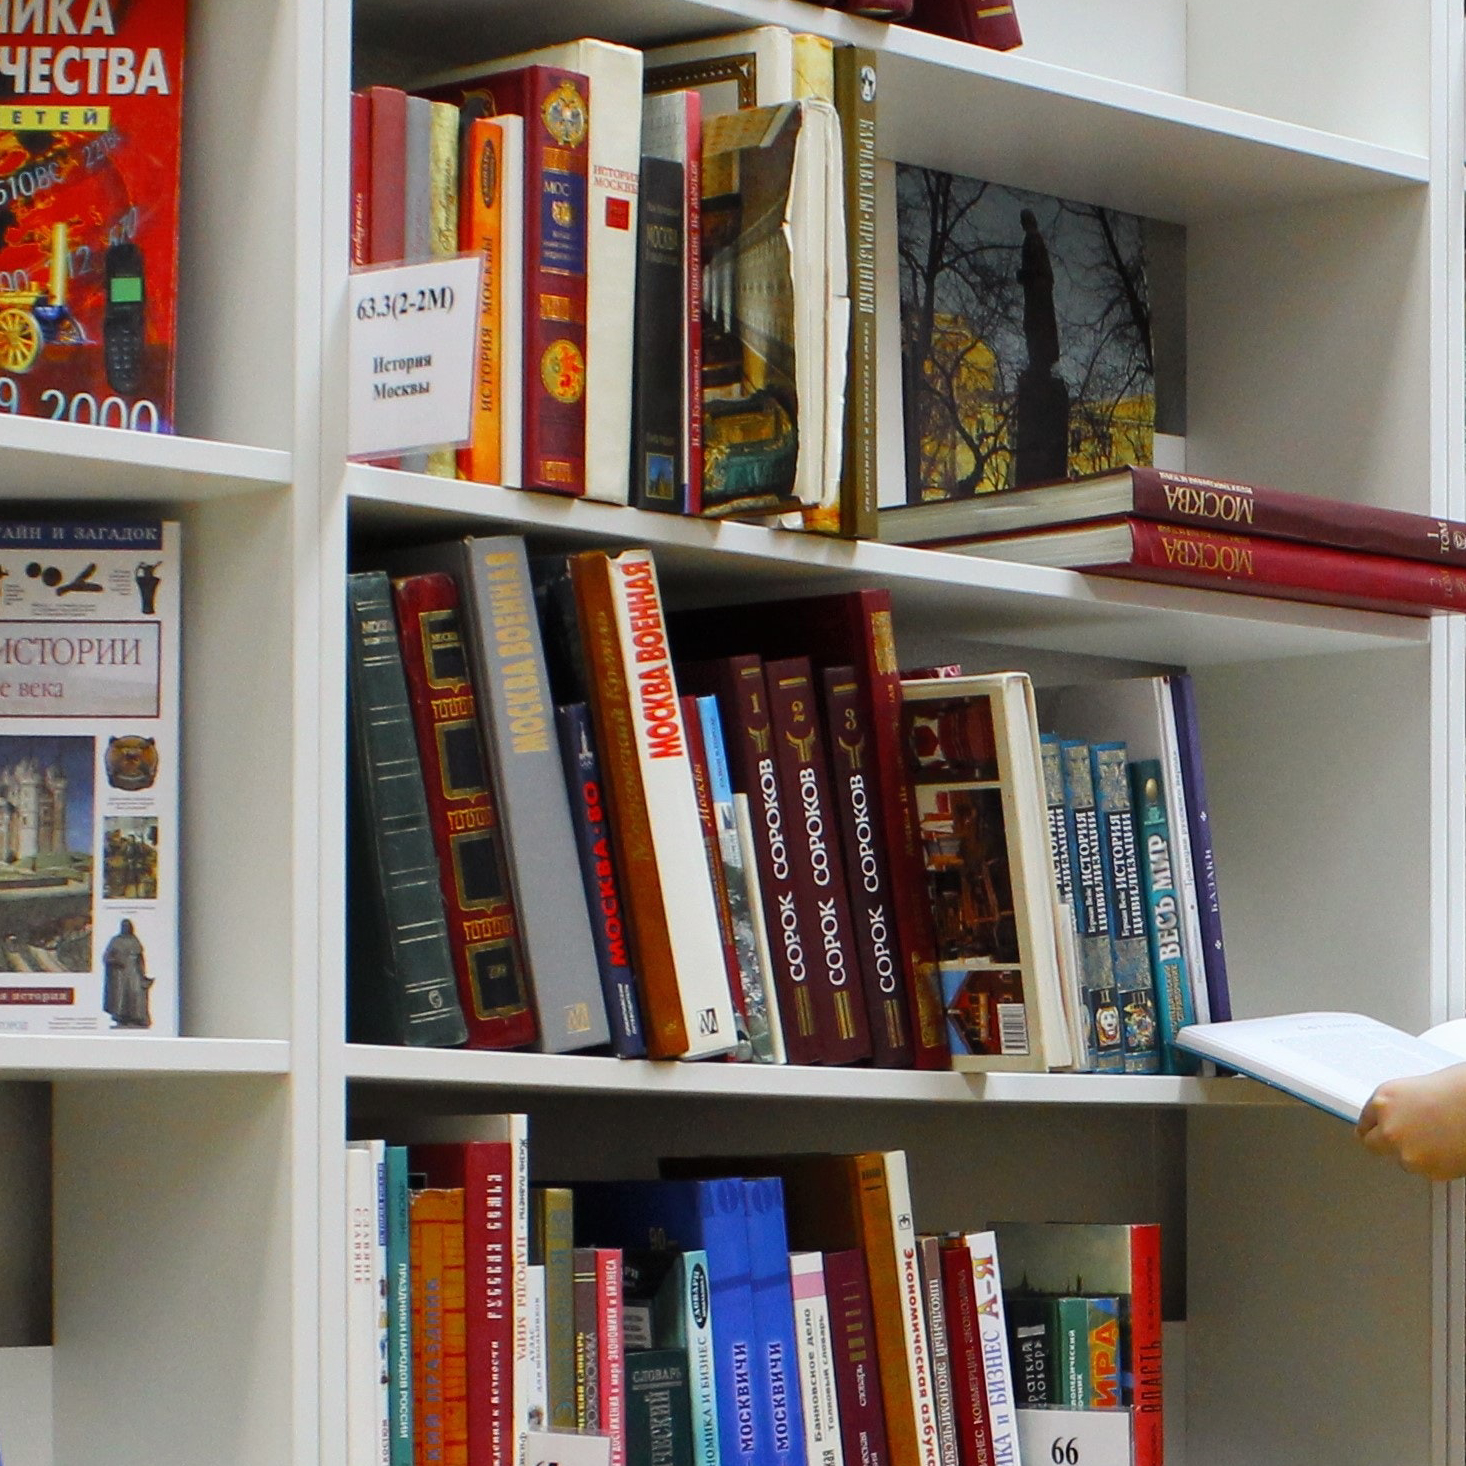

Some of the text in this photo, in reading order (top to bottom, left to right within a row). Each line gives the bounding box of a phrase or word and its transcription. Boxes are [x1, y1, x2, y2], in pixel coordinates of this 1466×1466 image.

[0, 45, 170, 96] ЧЕСТВА
[356, 284, 455, 323] 63.3(2-2М)
[480, 236, 494, 414] ИСТОРИЯ МОСКВЫ
[371, 351, 434, 375] История
[371, 376, 431, 402] Москвы
[51, 526, 158, 542] И ЗАГАДОК
[1162, 537, 1254, 576] МОСКВА
[1163, 485, 1255, 525] МОСКВА
[18, 681, 64, 698] века
[486, 552, 550, 754] МОСКВА ВОЕННАЯ
[621, 560, 683, 760] МОСКВА ВОЕННАЯ
[593, 838, 628, 967] МОСКВА
[758, 758, 806, 983] СОРОК СОРОКОВ
[799, 767, 848, 988] СОРОК СОРОКОВ
[849, 773, 897, 995] СОРОК СОРОКОВ
[1086, 810, 1109, 931] ЦИВИЛИЗАЦИИ
[1121, 812, 1144, 935] ЦИВИЛИЗАЦИИ
[1147, 834, 1181, 962] ВЕСЬ МИР
[426, 1277, 443, 1402] ПРАЗДНИК
[697, 1336, 710, 1390] БИЗНЕС
[903, 1247, 929, 1398] Экономическая
[929, 1278, 947, 1357] ШКОЛЬНЫЙ
[702, 1393, 711, 1405] И
[732, 1342, 755, 1453] МОСКВИЧИ
[767, 1341, 790, 1451] МОСКВИЧИ
[802, 1308, 823, 1443] Банковское дело
[1050, 1437, 1080, 1466] 66
